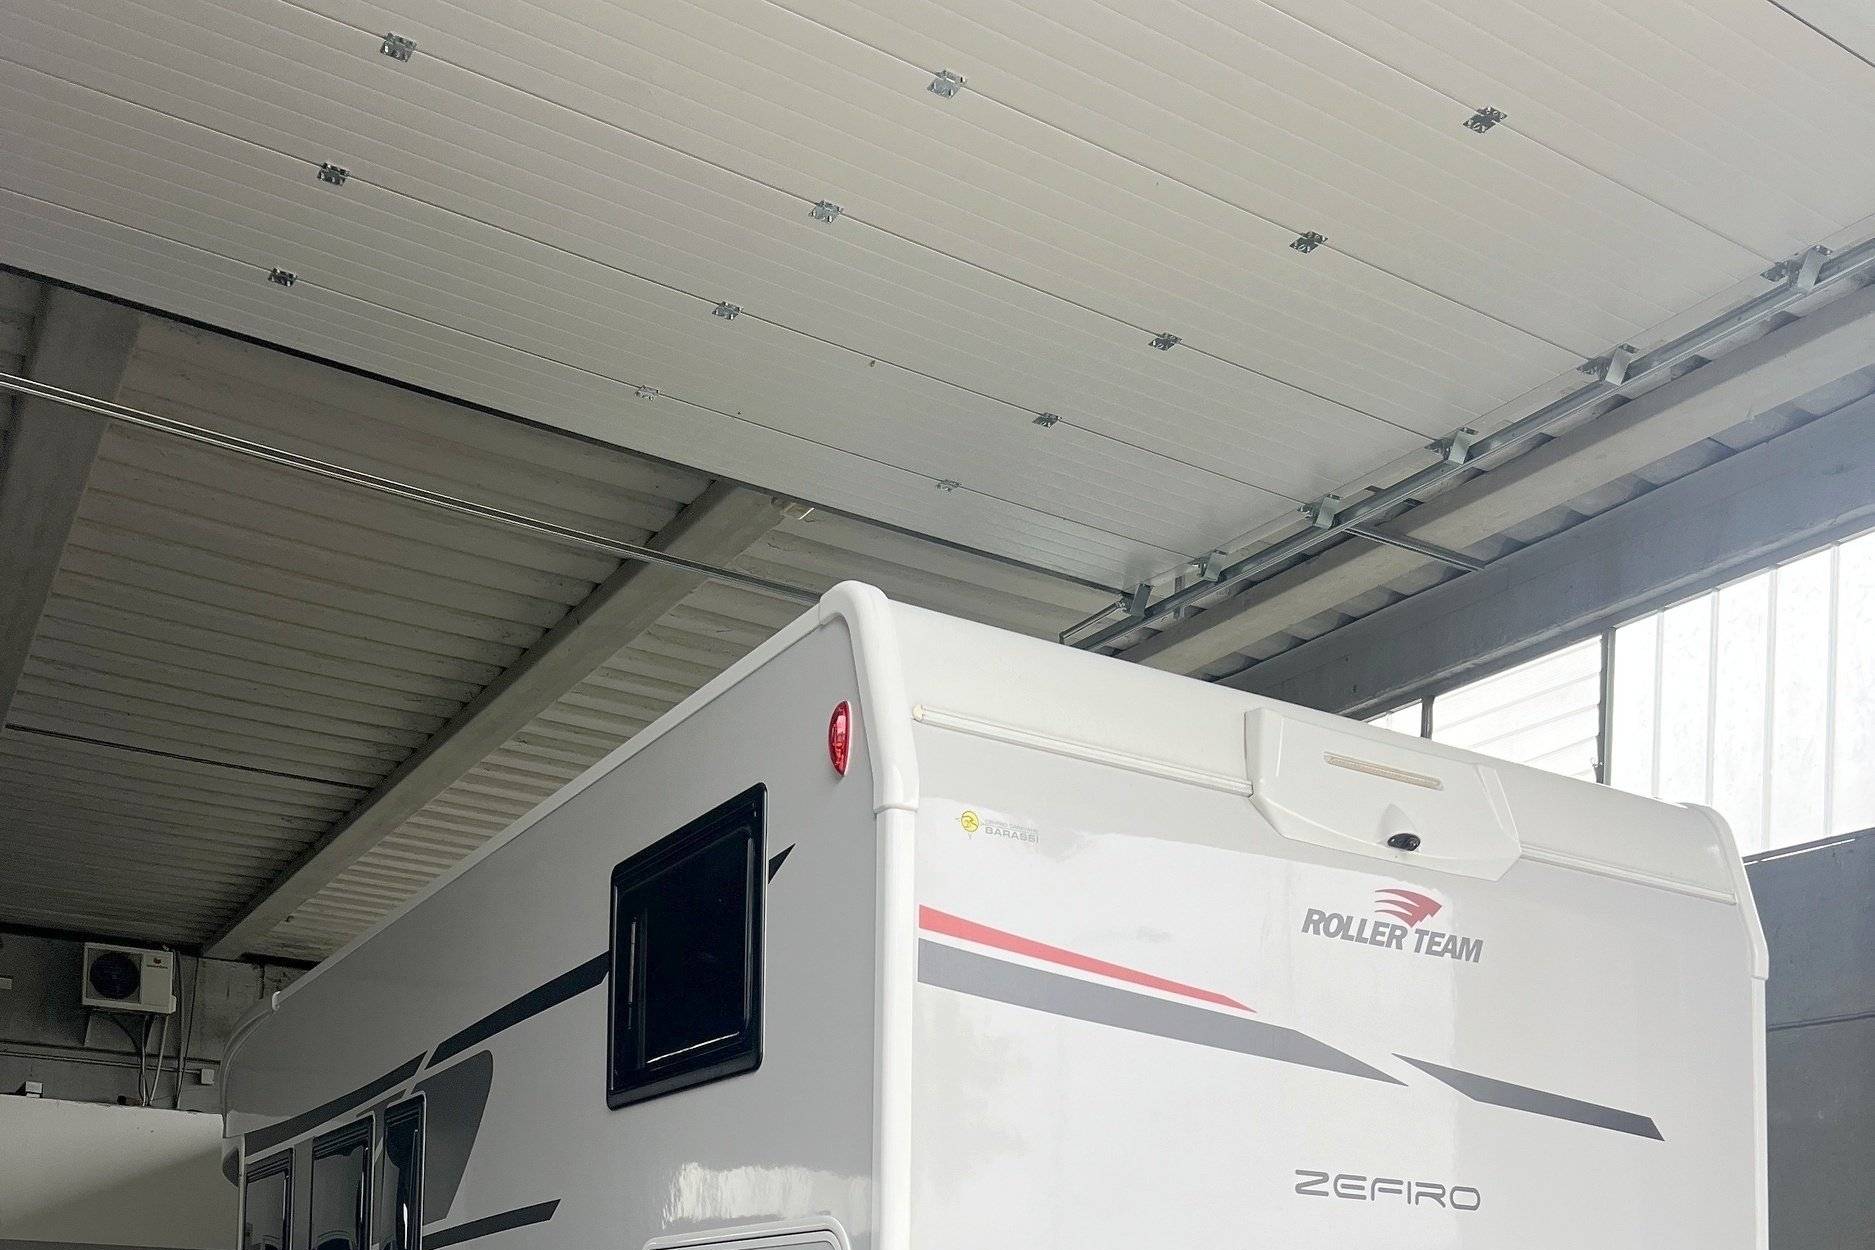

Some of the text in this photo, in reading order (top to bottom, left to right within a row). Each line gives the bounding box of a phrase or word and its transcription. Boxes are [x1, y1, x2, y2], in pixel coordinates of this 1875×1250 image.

[1301, 908, 1484, 963] ROLLER TEAM
[1295, 1169, 1481, 1211] ZEFIRO
